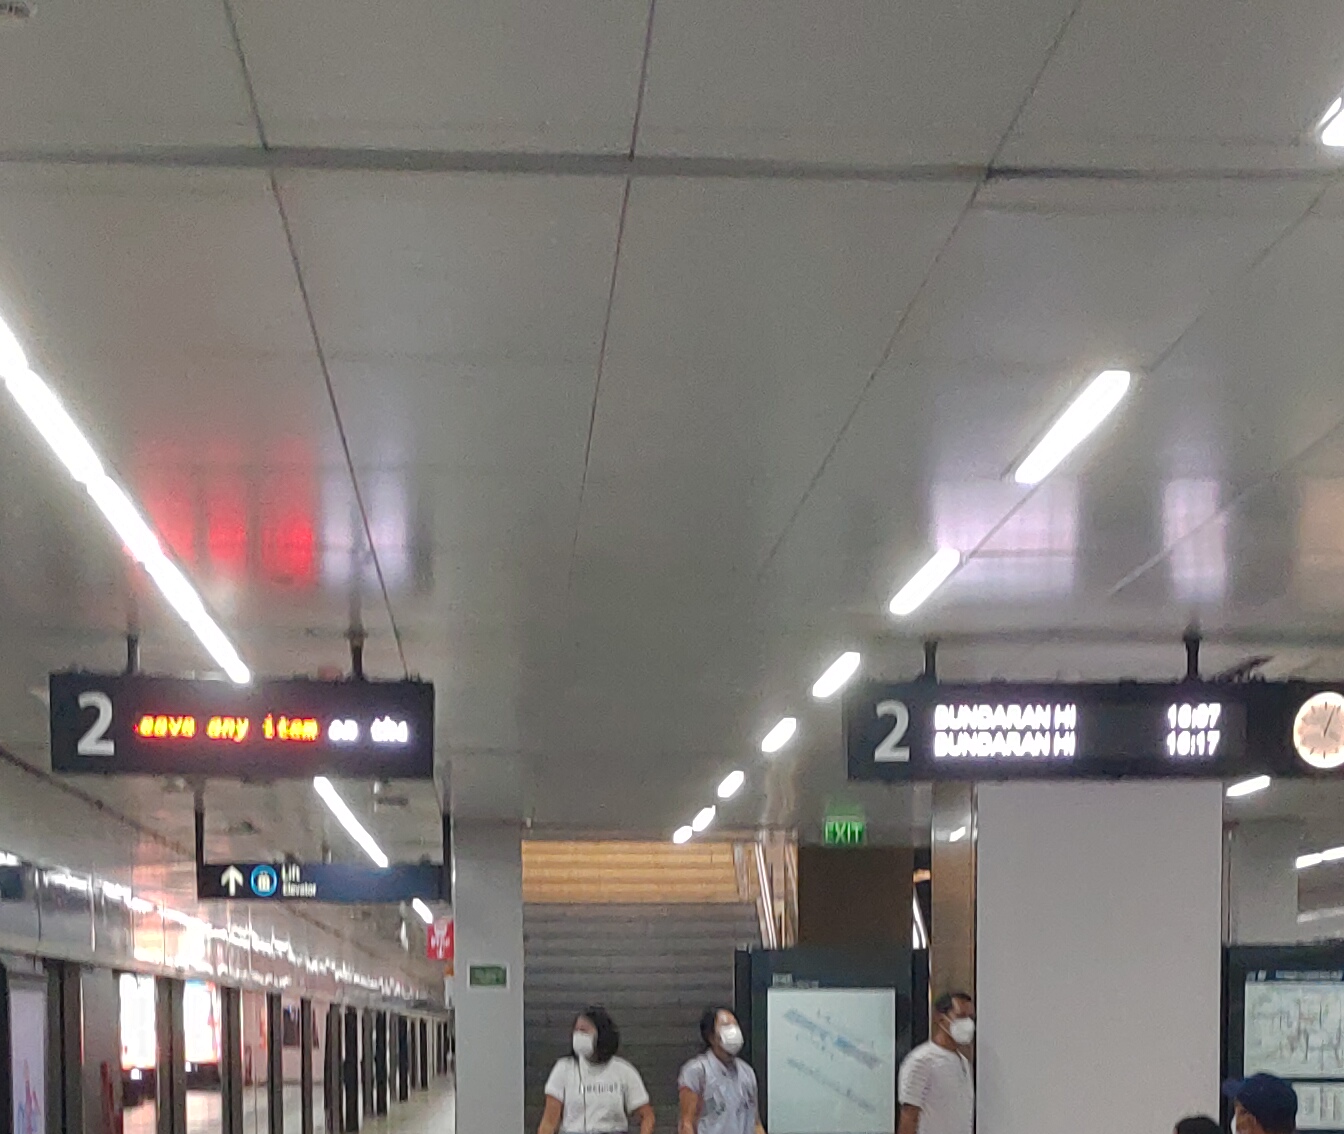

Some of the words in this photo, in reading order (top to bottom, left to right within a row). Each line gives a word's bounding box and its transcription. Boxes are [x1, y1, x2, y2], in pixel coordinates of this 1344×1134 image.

[77, 691, 115, 756] 2
[206, 715, 249, 742] any
[934, 704, 1051, 730] BUNDARAN
[1054, 703, 1076, 730] HI
[874, 700, 910, 762] 2
[934, 731, 1051, 757] BUNDARAN
[1053, 731, 1076, 757] HI
[825, 821, 864, 845] EXIT
[282, 863, 301, 882] Lift
